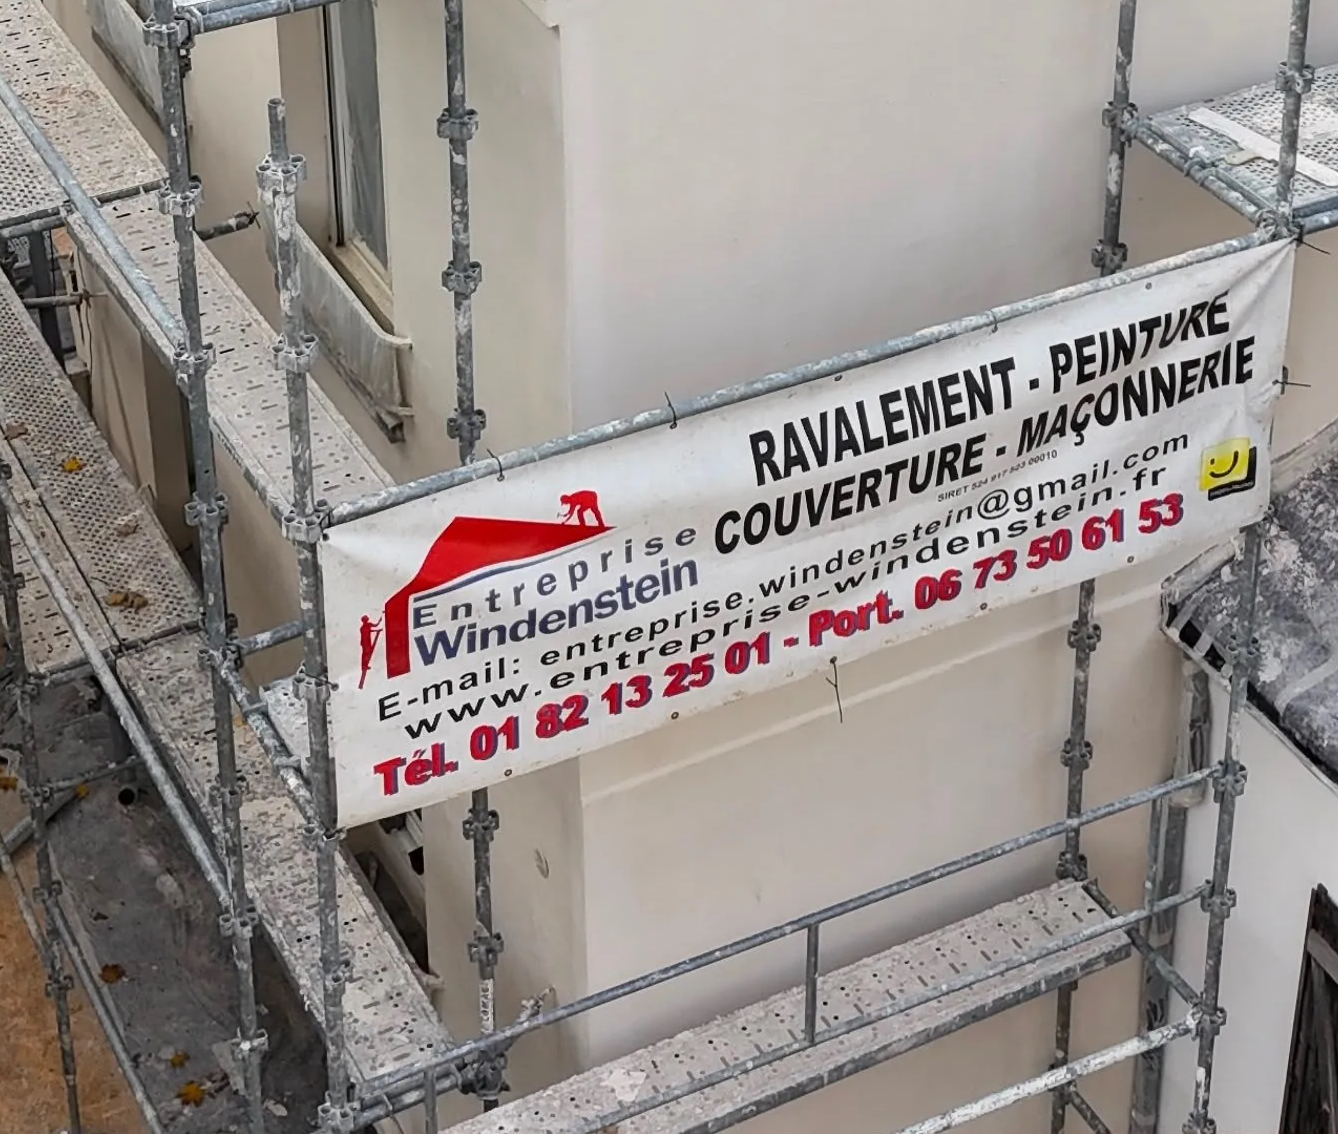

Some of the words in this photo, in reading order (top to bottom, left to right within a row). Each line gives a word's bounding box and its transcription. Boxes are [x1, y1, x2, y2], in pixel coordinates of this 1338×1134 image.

[715, 433, 987, 554] COUVERTURE
[996, 445, 1007, 457] -
[1016, 336, 1255, 457] MAÇONNERIE
[749, 356, 1017, 486] RAVALEMENT
[1029, 377, 1040, 390] -
[1049, 290, 1231, 394] PEINTURE
[378, 657, 521, 721] E-mail:
[540, 434, 1188, 666] entreprise.windenstein@gmail.com
[413, 527, 697, 629] Entreprise
[937, 485, 968, 502] SIRET
[373, 742, 459, 796] Tél.
[469, 715, 520, 761] 01
[535, 694, 590, 739] 82
[601, 675, 653, 715] 13
[662, 653, 715, 698] 25
[724, 631, 771, 674] 01
[783, 636, 800, 648] -
[809, 590, 905, 647] Port.
[914, 568, 963, 610] 06
[972, 550, 1018, 589] 73
[1026, 527, 1073, 569] 50
[1081, 508, 1125, 551] 61
[1138, 493, 1184, 534] 53
[404, 466, 1166, 739] www.entreprise-windenstein.fr
[414, 557, 699, 667] Windenstein
